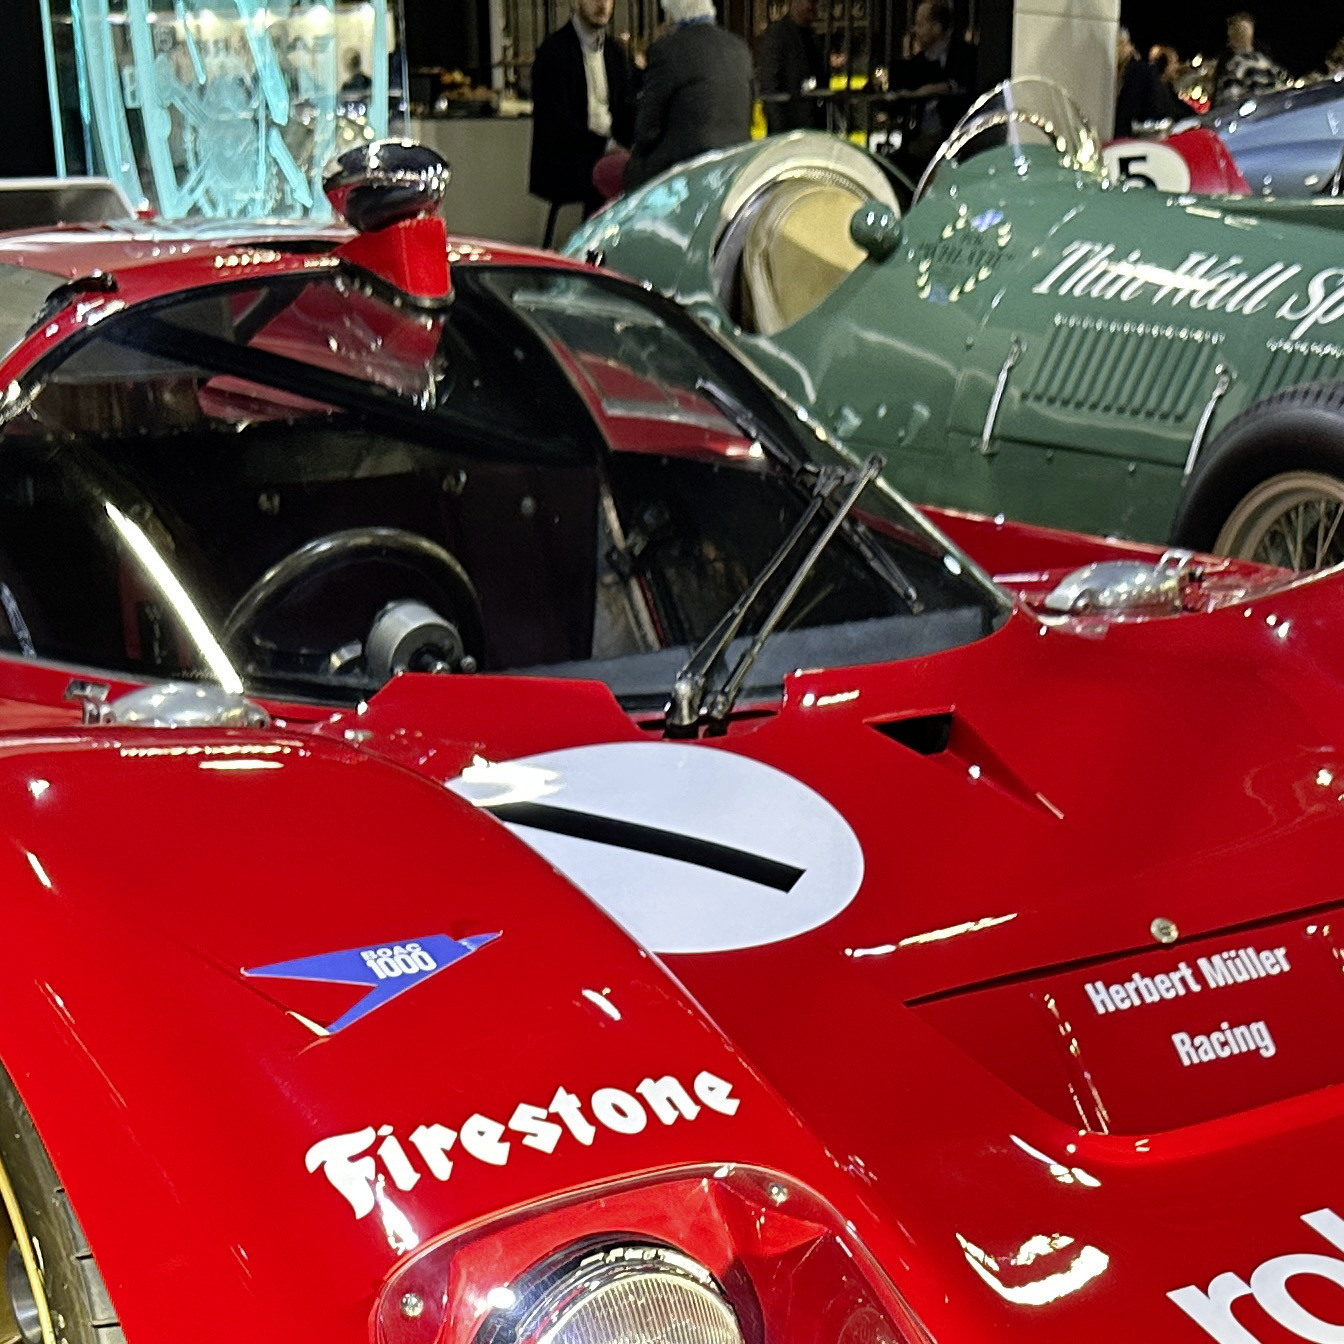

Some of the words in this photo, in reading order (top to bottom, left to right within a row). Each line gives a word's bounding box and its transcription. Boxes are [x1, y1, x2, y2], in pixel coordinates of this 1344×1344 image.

[1032, 239, 1148, 302] Thin
[1151, 250, 1302, 315] Wall
[360, 942, 422, 961] BOAC
[366, 950, 438, 980] 1000
[1084, 966, 1202, 1015] Herbert
[1196, 946, 1292, 989] Müller
[1171, 1020, 1277, 1068] Racing
[305, 1070, 742, 1220] Firestone
